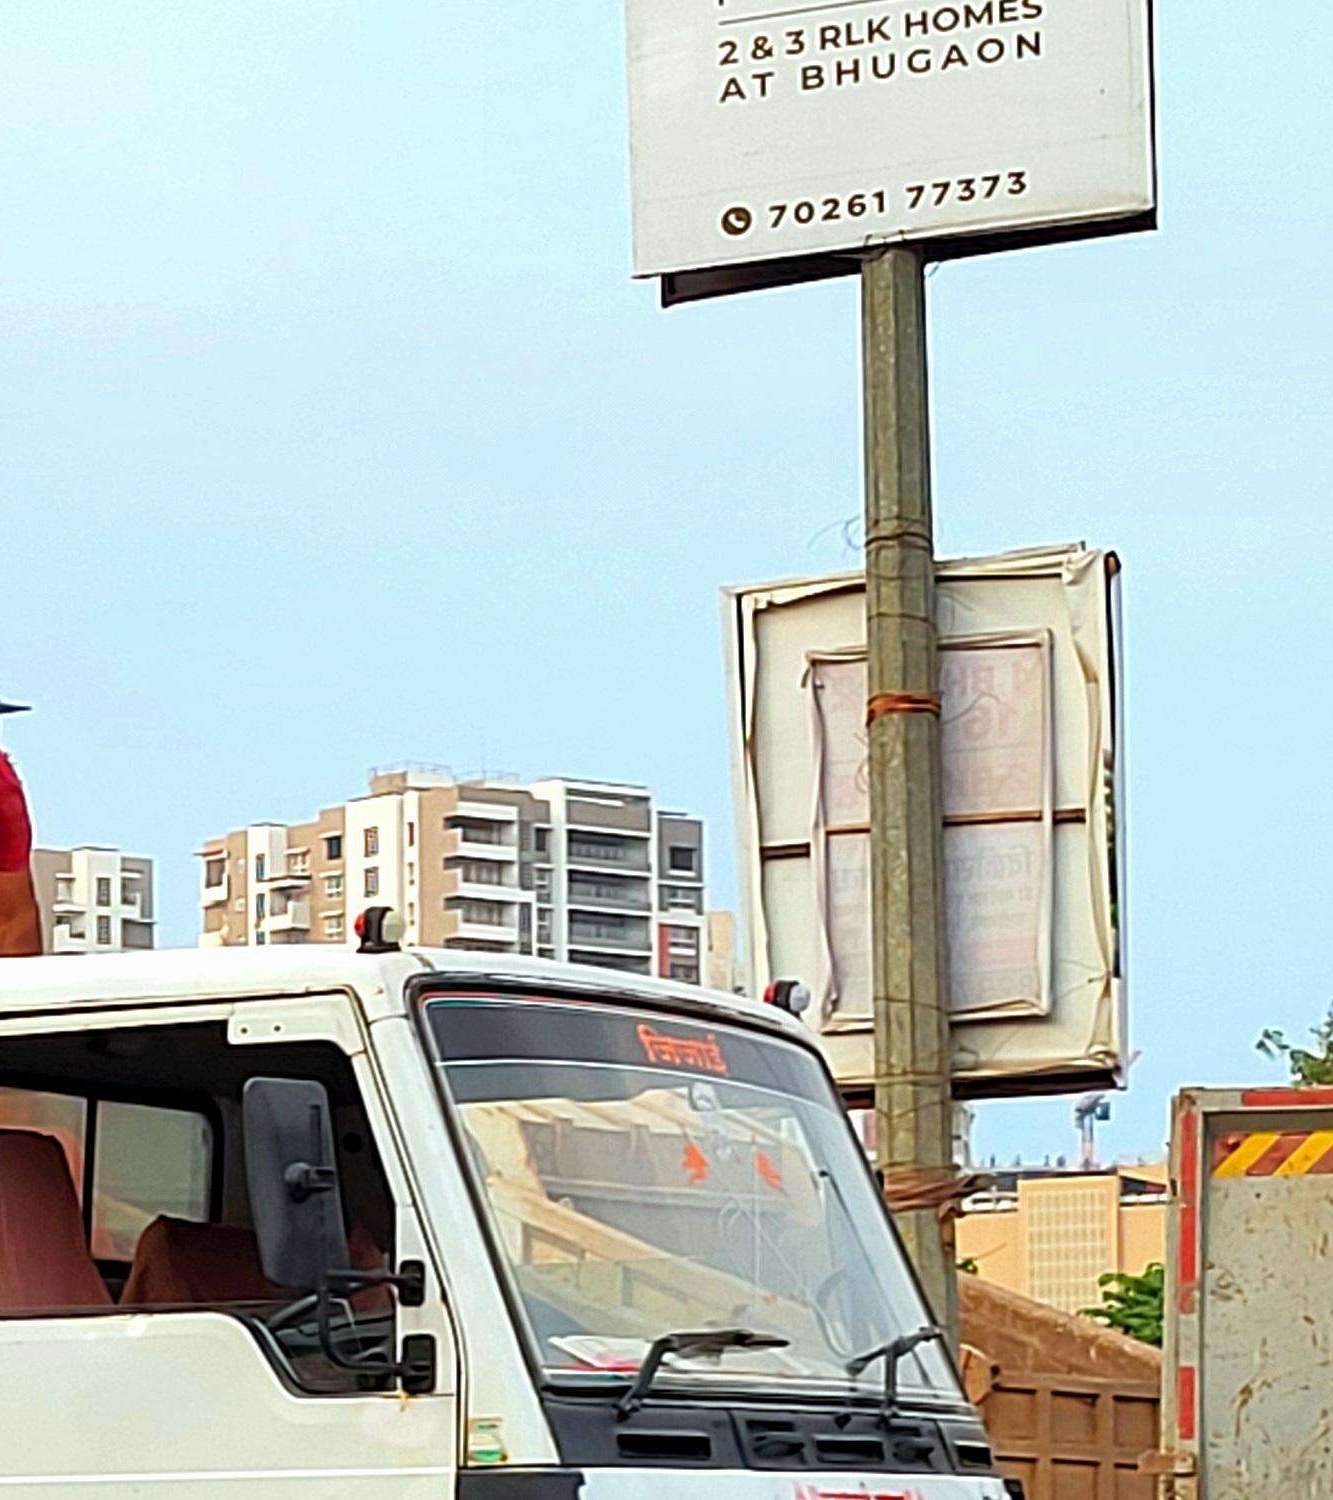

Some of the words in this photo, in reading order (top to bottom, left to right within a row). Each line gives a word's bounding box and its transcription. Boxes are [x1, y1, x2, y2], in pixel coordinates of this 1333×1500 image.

[718, 40, 738, 66] 2
[751, 36, 774, 60] &
[785, 30, 805, 55] 3
[819, 16, 891, 50] RLK
[904, 0, 1043, 37] HOMES
[719, 71, 775, 103] AT
[800, 31, 1041, 90] BHUGAON
[769, 190, 885, 228] 70261
[906, 171, 1027, 209] 77373
